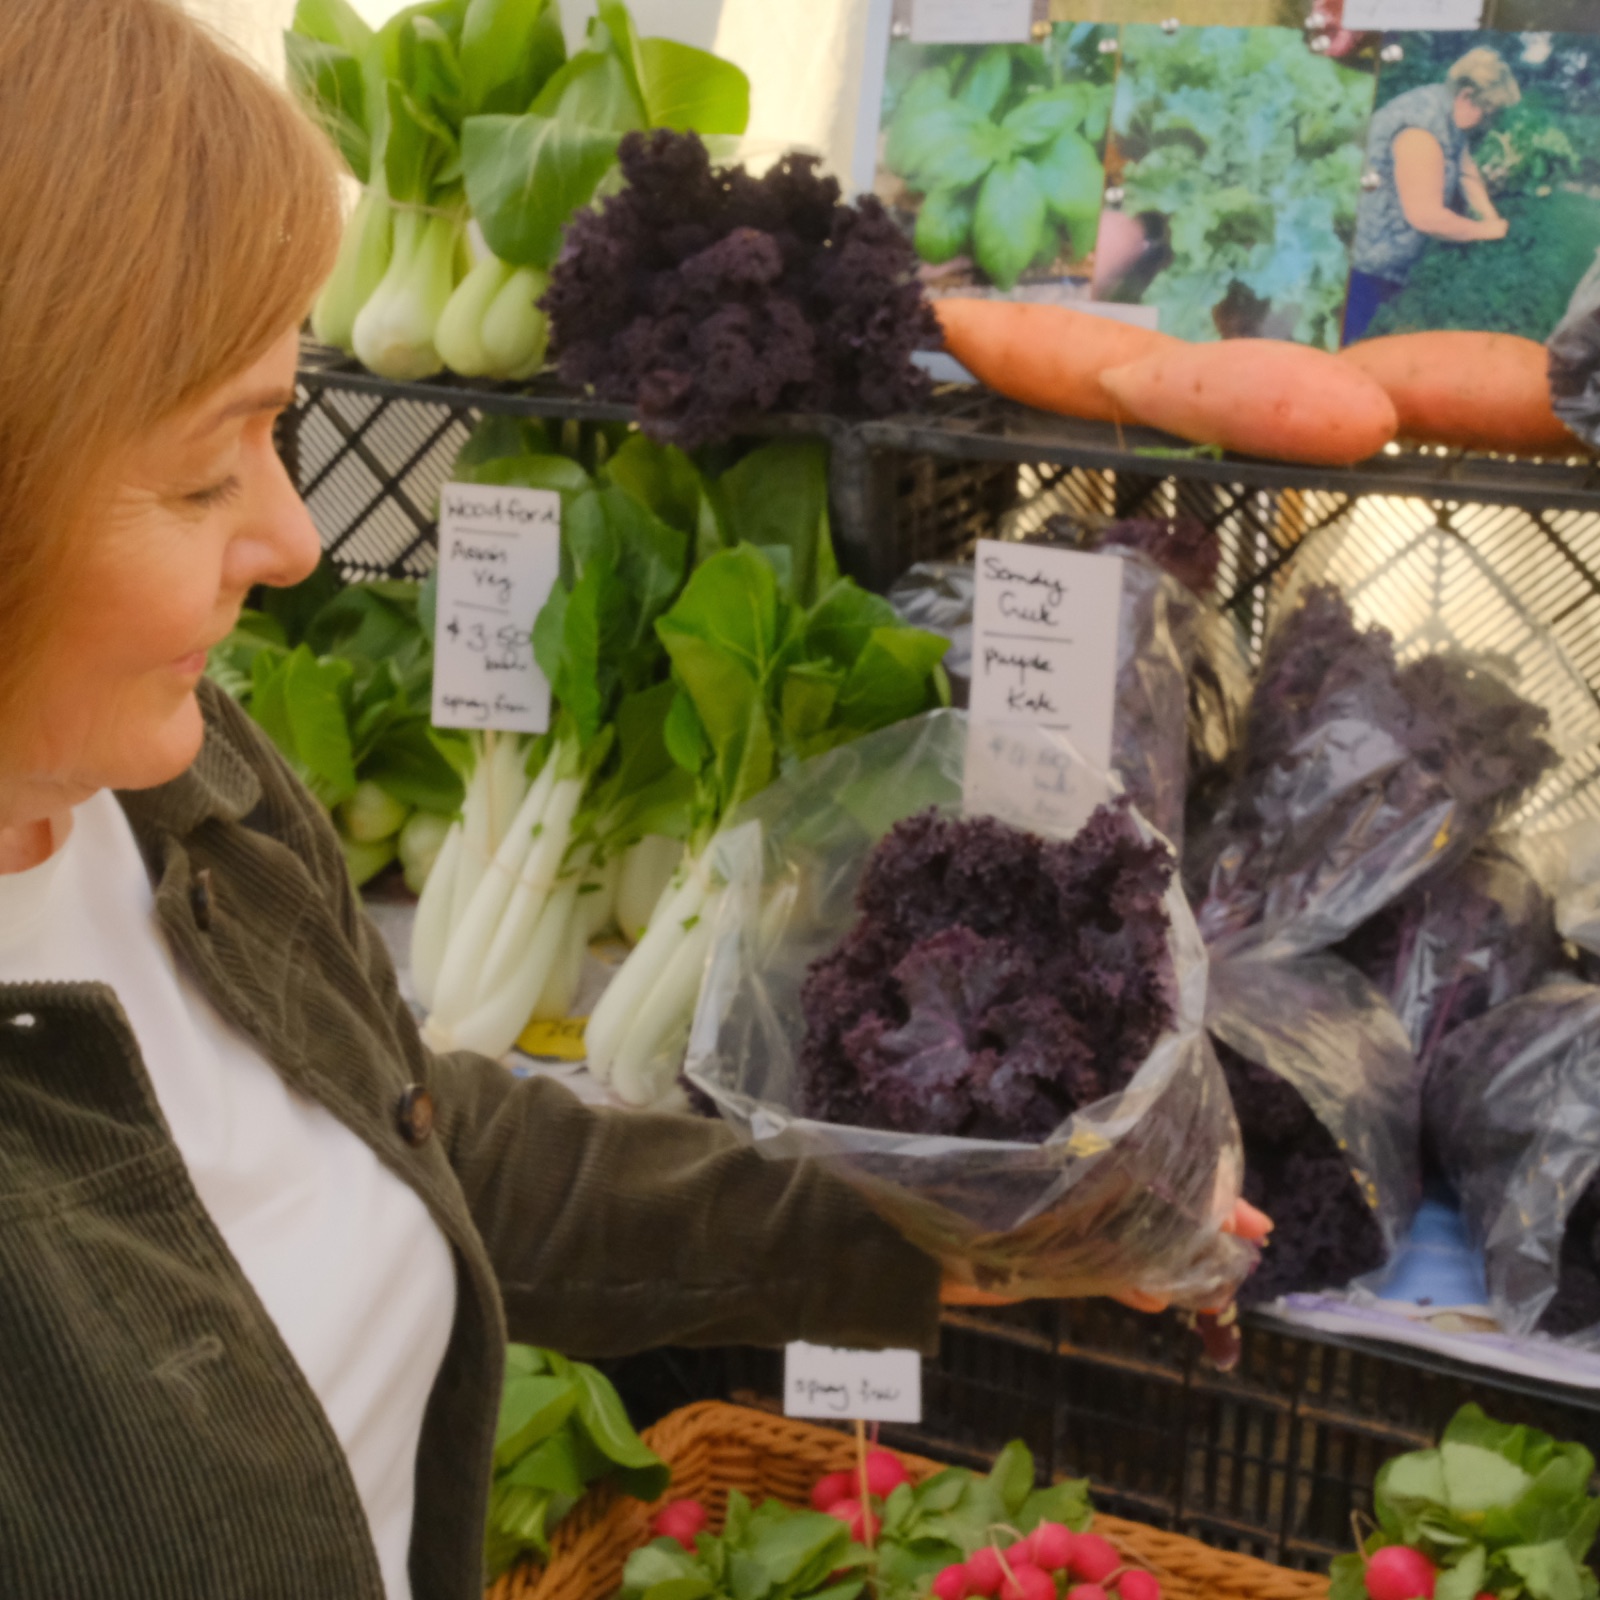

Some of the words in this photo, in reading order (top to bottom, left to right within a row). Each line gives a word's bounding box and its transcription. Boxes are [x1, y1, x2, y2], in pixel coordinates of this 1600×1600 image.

[984, 556, 1067, 608] Sandy
[999, 591, 1059, 627] Creek
[1007, 687, 1058, 714] Kale
